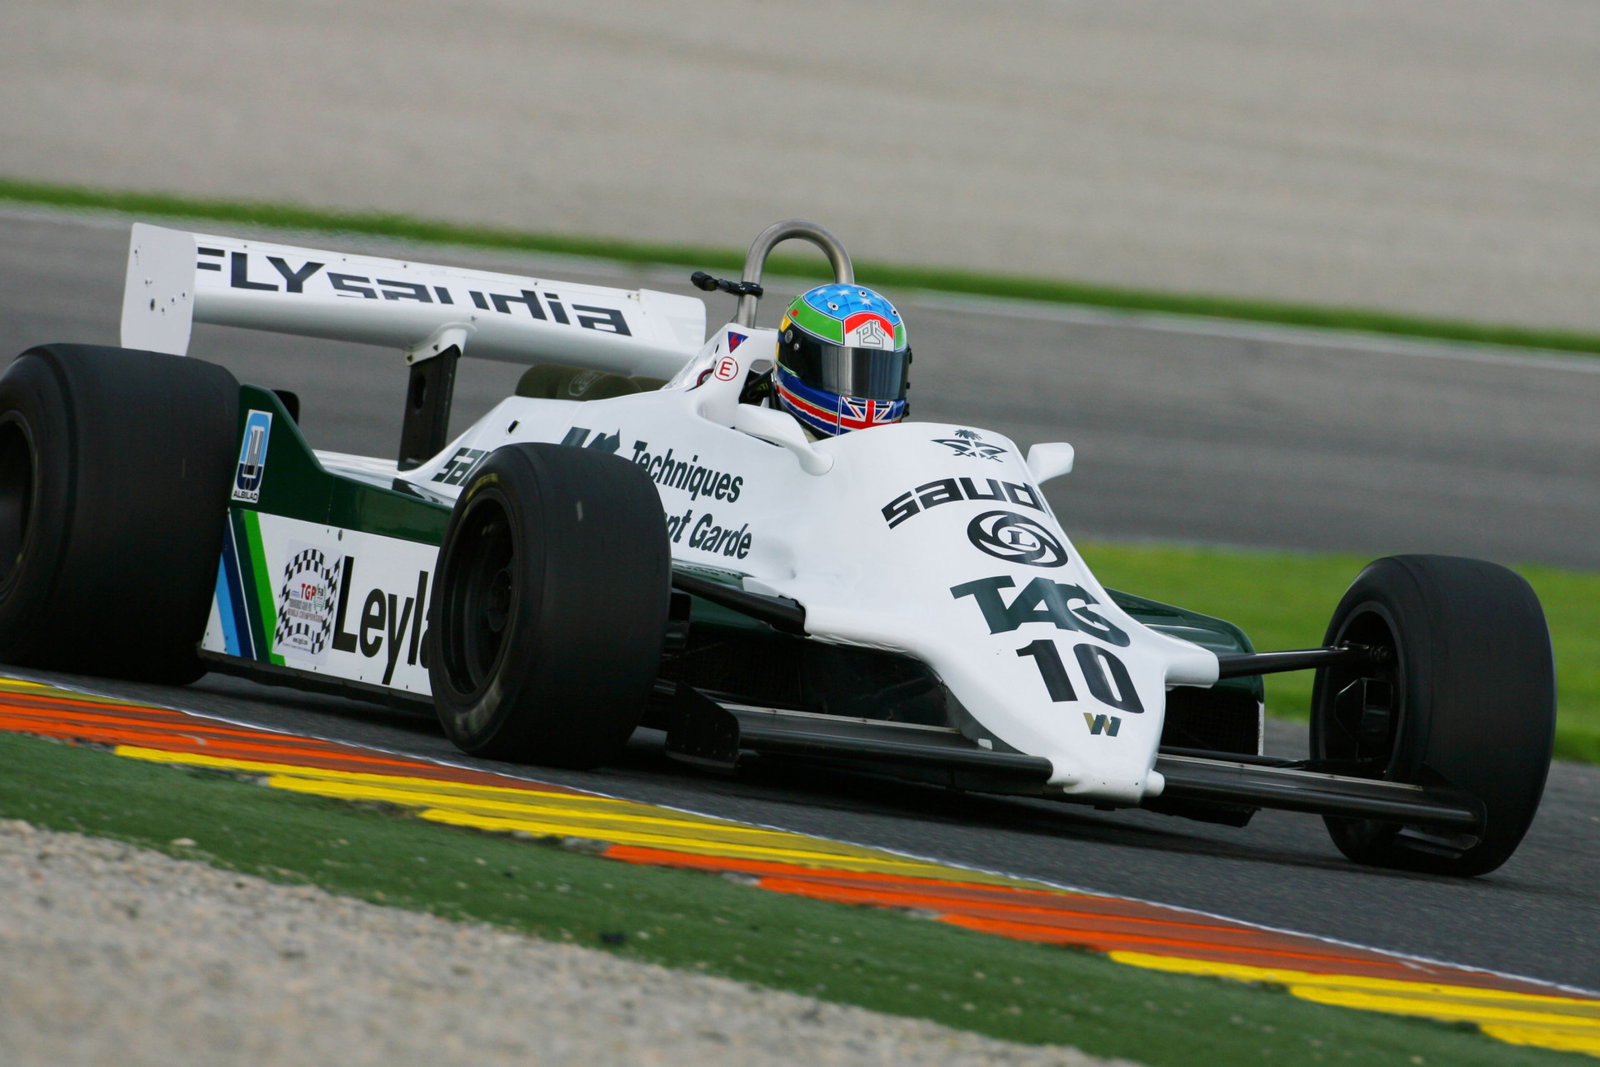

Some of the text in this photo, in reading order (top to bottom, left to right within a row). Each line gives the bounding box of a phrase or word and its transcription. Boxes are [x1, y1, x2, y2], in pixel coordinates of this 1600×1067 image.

[718, 360, 733, 377] E
[630, 438, 744, 504] Techniques
[688, 512, 753, 560] Garde
[300, 583, 317, 600] TGP
[331, 554, 431, 686] Leyl
[1015, 638, 1145, 714] 10
